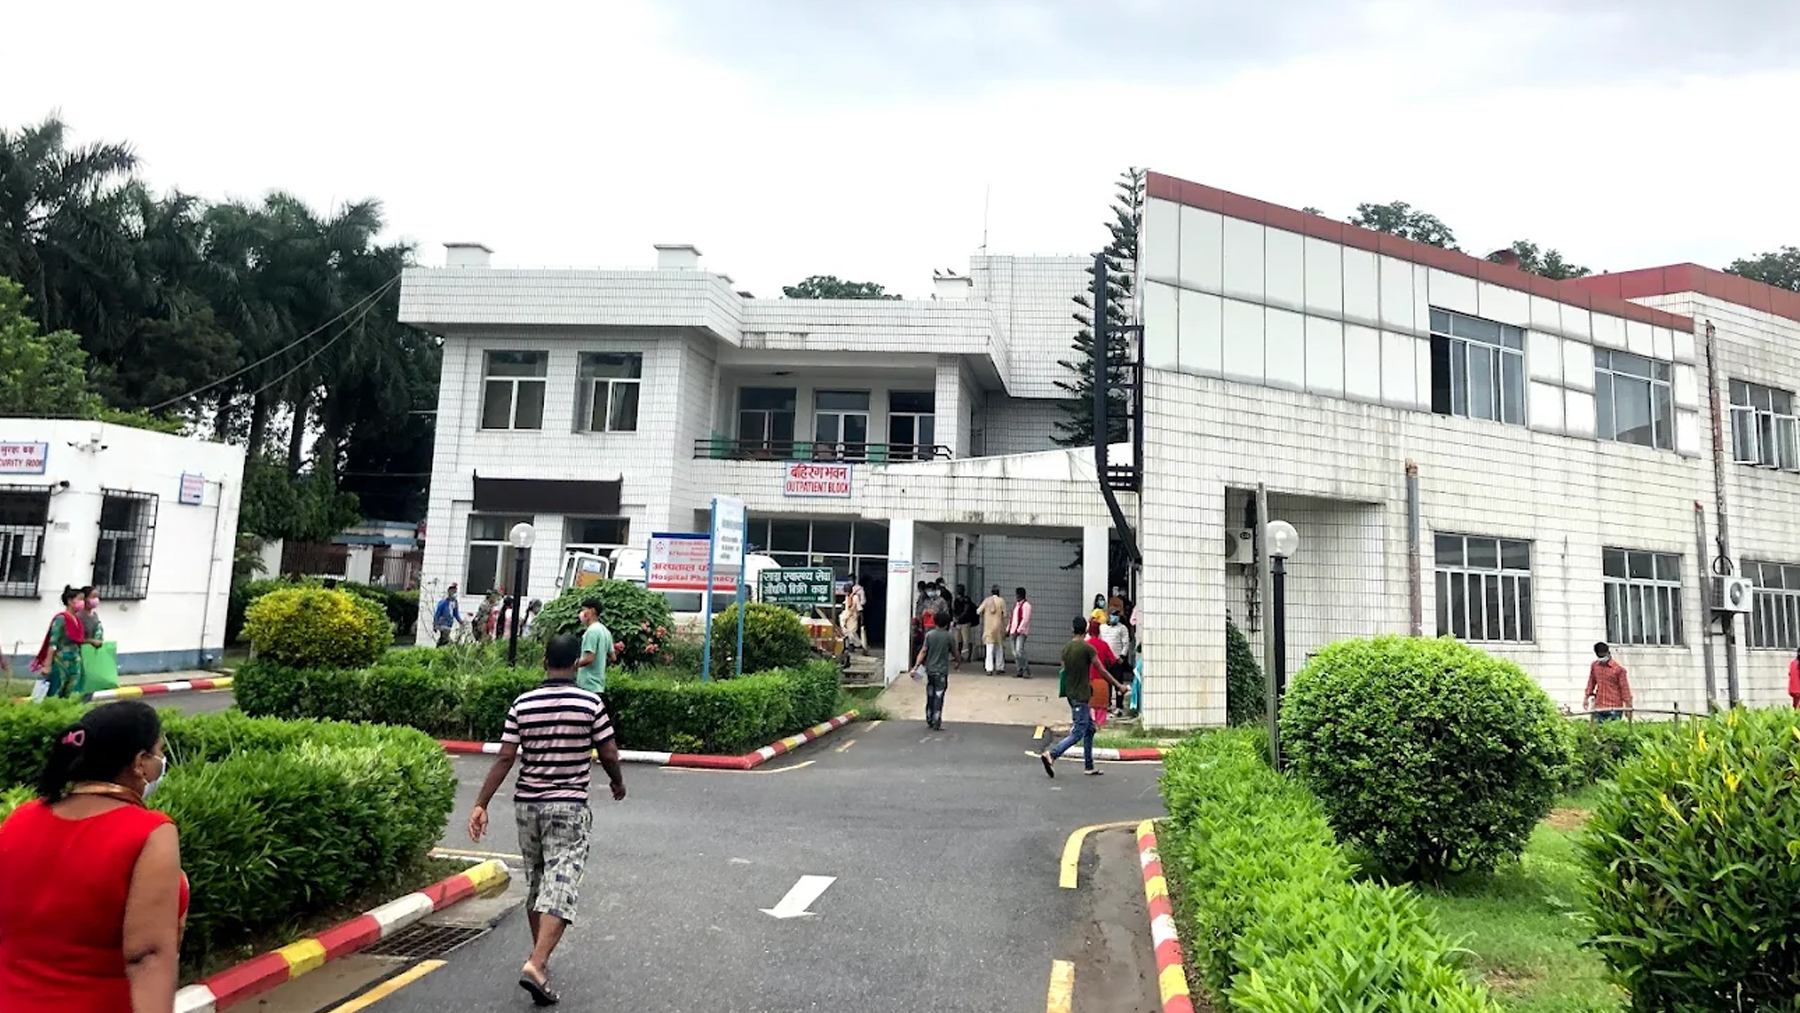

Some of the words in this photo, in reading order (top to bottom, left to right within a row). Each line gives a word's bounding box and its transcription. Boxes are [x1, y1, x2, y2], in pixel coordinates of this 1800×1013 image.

[825, 466, 848, 479] भवन
[786, 481, 827, 492] OUTPATIENT
[828, 482, 848, 493] BLOCK
[651, 573, 688, 581] Hospital
[690, 575, 735, 583] Phamacy
[815, 569, 831, 582] सेवा
